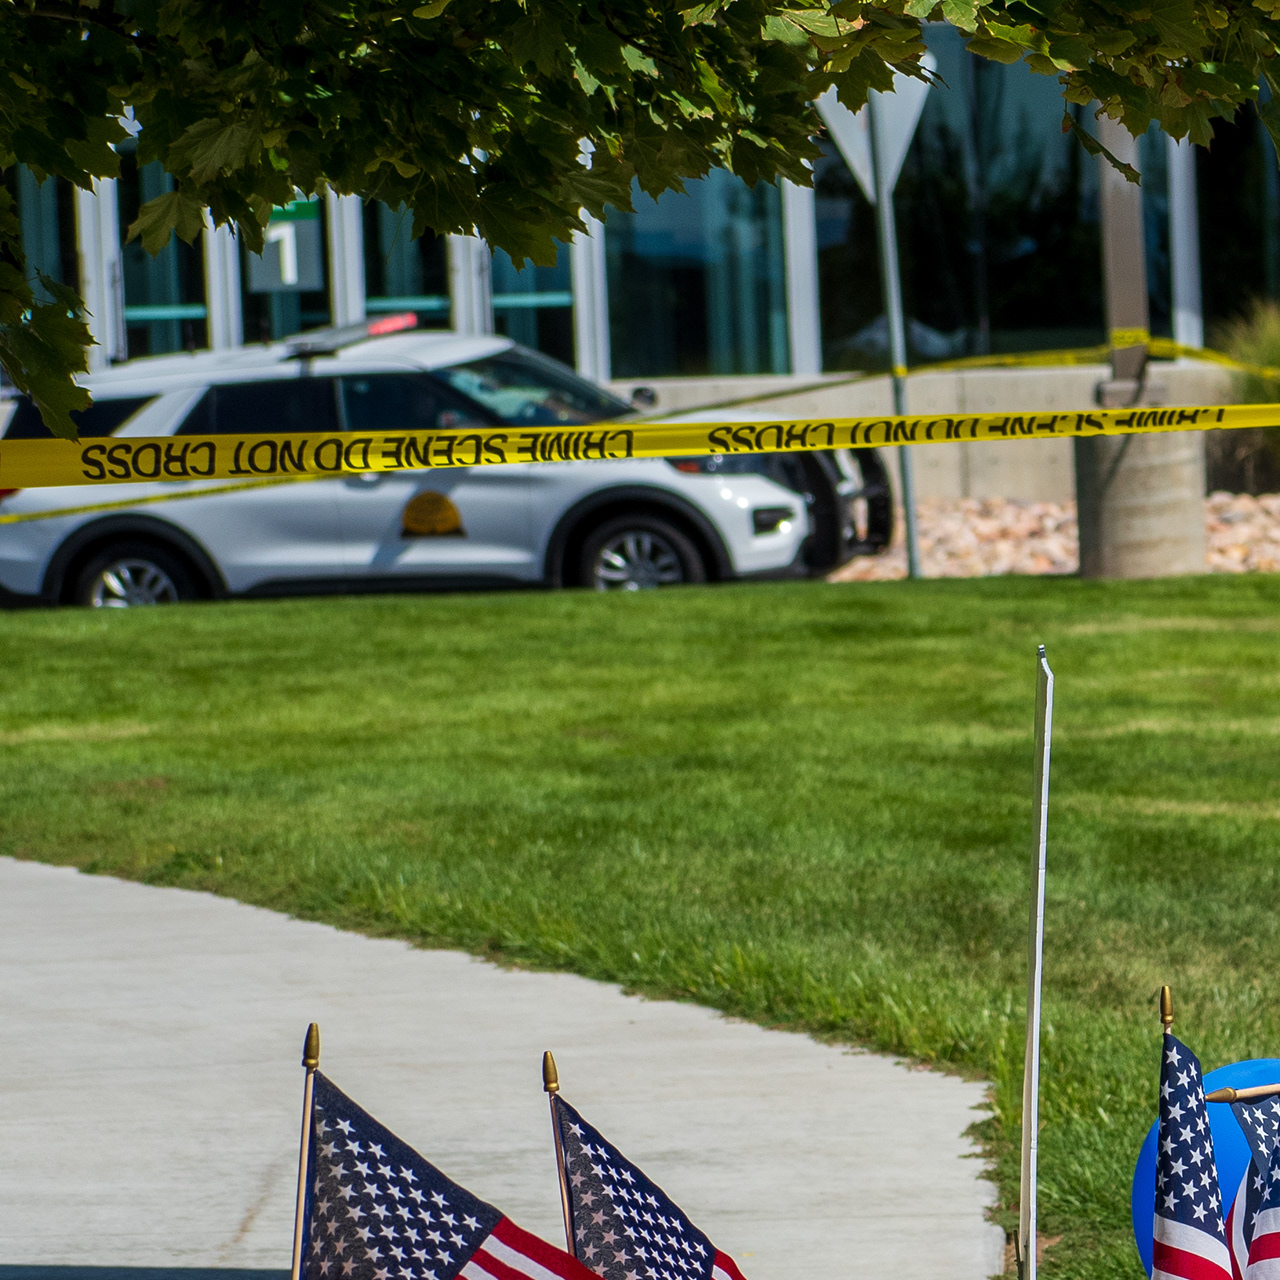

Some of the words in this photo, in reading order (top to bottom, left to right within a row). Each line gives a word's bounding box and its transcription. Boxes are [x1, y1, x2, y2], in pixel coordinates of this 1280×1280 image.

[266, 221, 299, 285] 1
[81, 441, 217, 481] CROSS
[228, 438, 309, 476] NOT
[314, 437, 374, 471] DO
[382, 433, 509, 469] SCENE
[517, 429, 635, 461] CRIME
